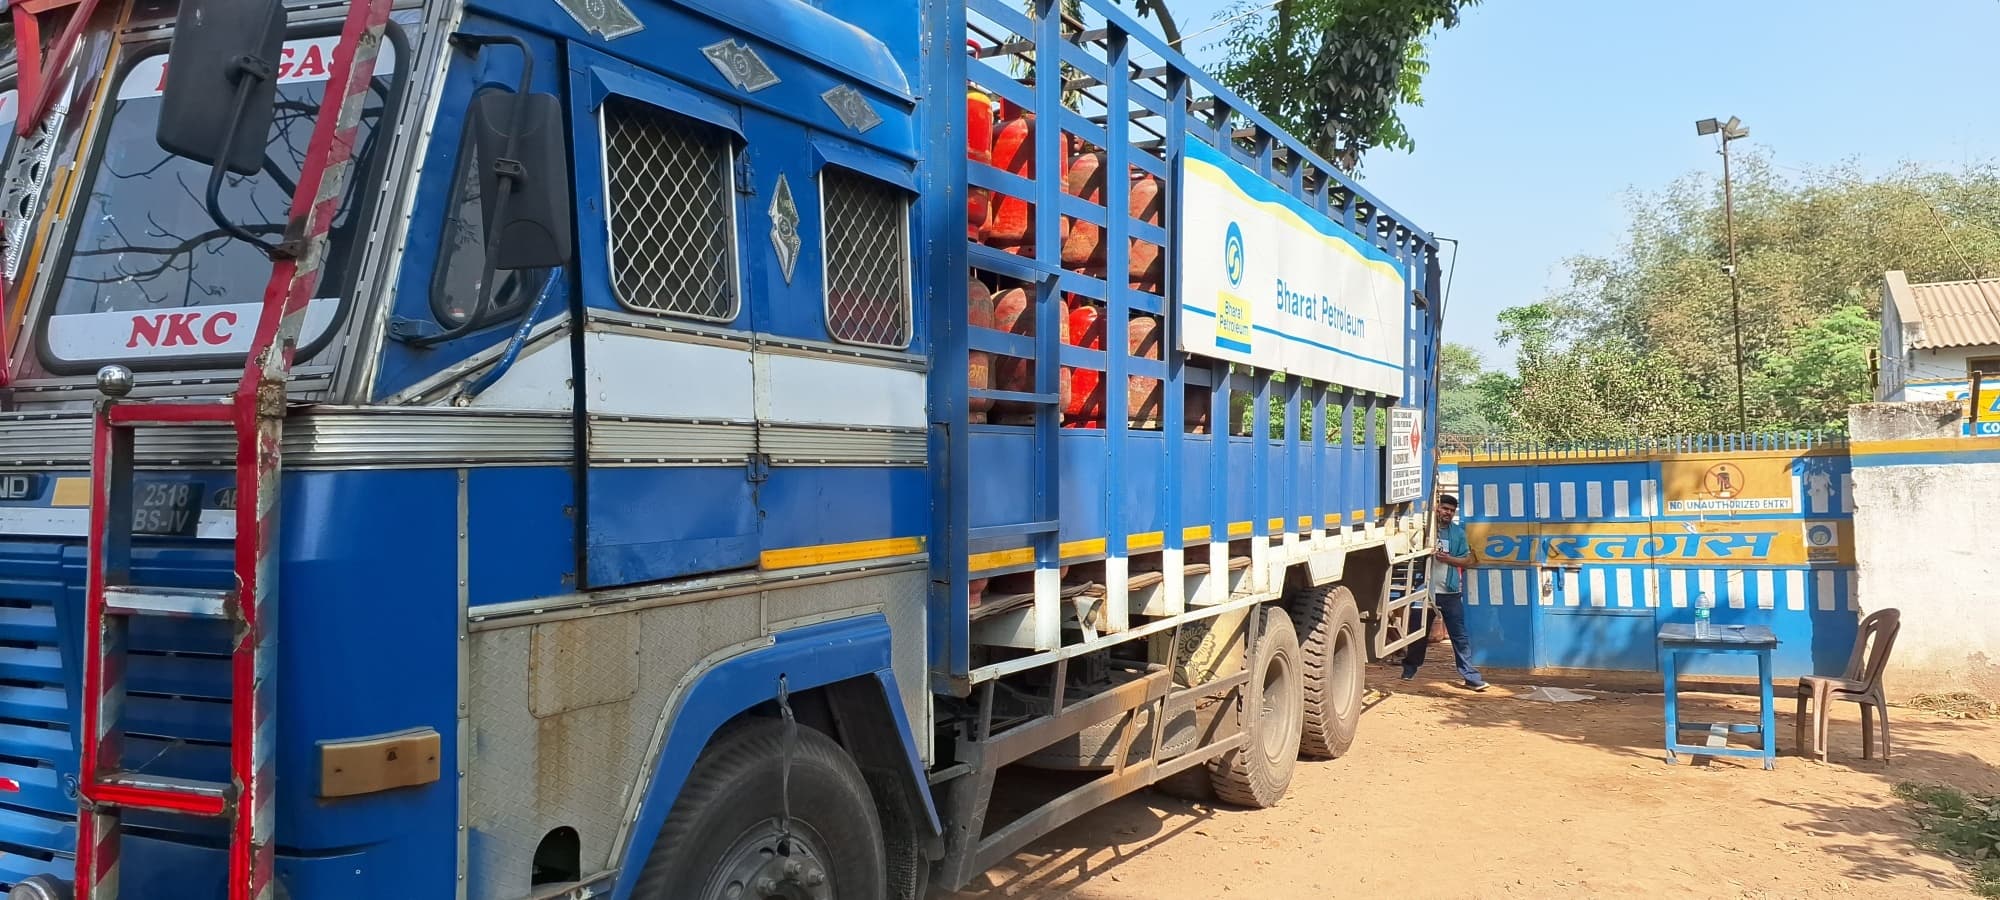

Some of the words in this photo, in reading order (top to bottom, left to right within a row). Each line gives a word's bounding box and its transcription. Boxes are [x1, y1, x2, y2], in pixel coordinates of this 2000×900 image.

[1224, 300, 1243, 320] Bharat
[1276, 278, 1317, 321] Bharat
[1321, 295, 1365, 339] Petroleum
[126, 311, 237, 348] NKC
[1219, 316, 1249, 336] Petroleum
[143, 483, 190, 507] 2518
[1669, 501, 1683, 510] NO
[1686, 500, 1760, 510] UNAUTHORIZED
[1763, 499, 1789, 509] ENTRY
[132, 509, 191, 533] BS-IV
